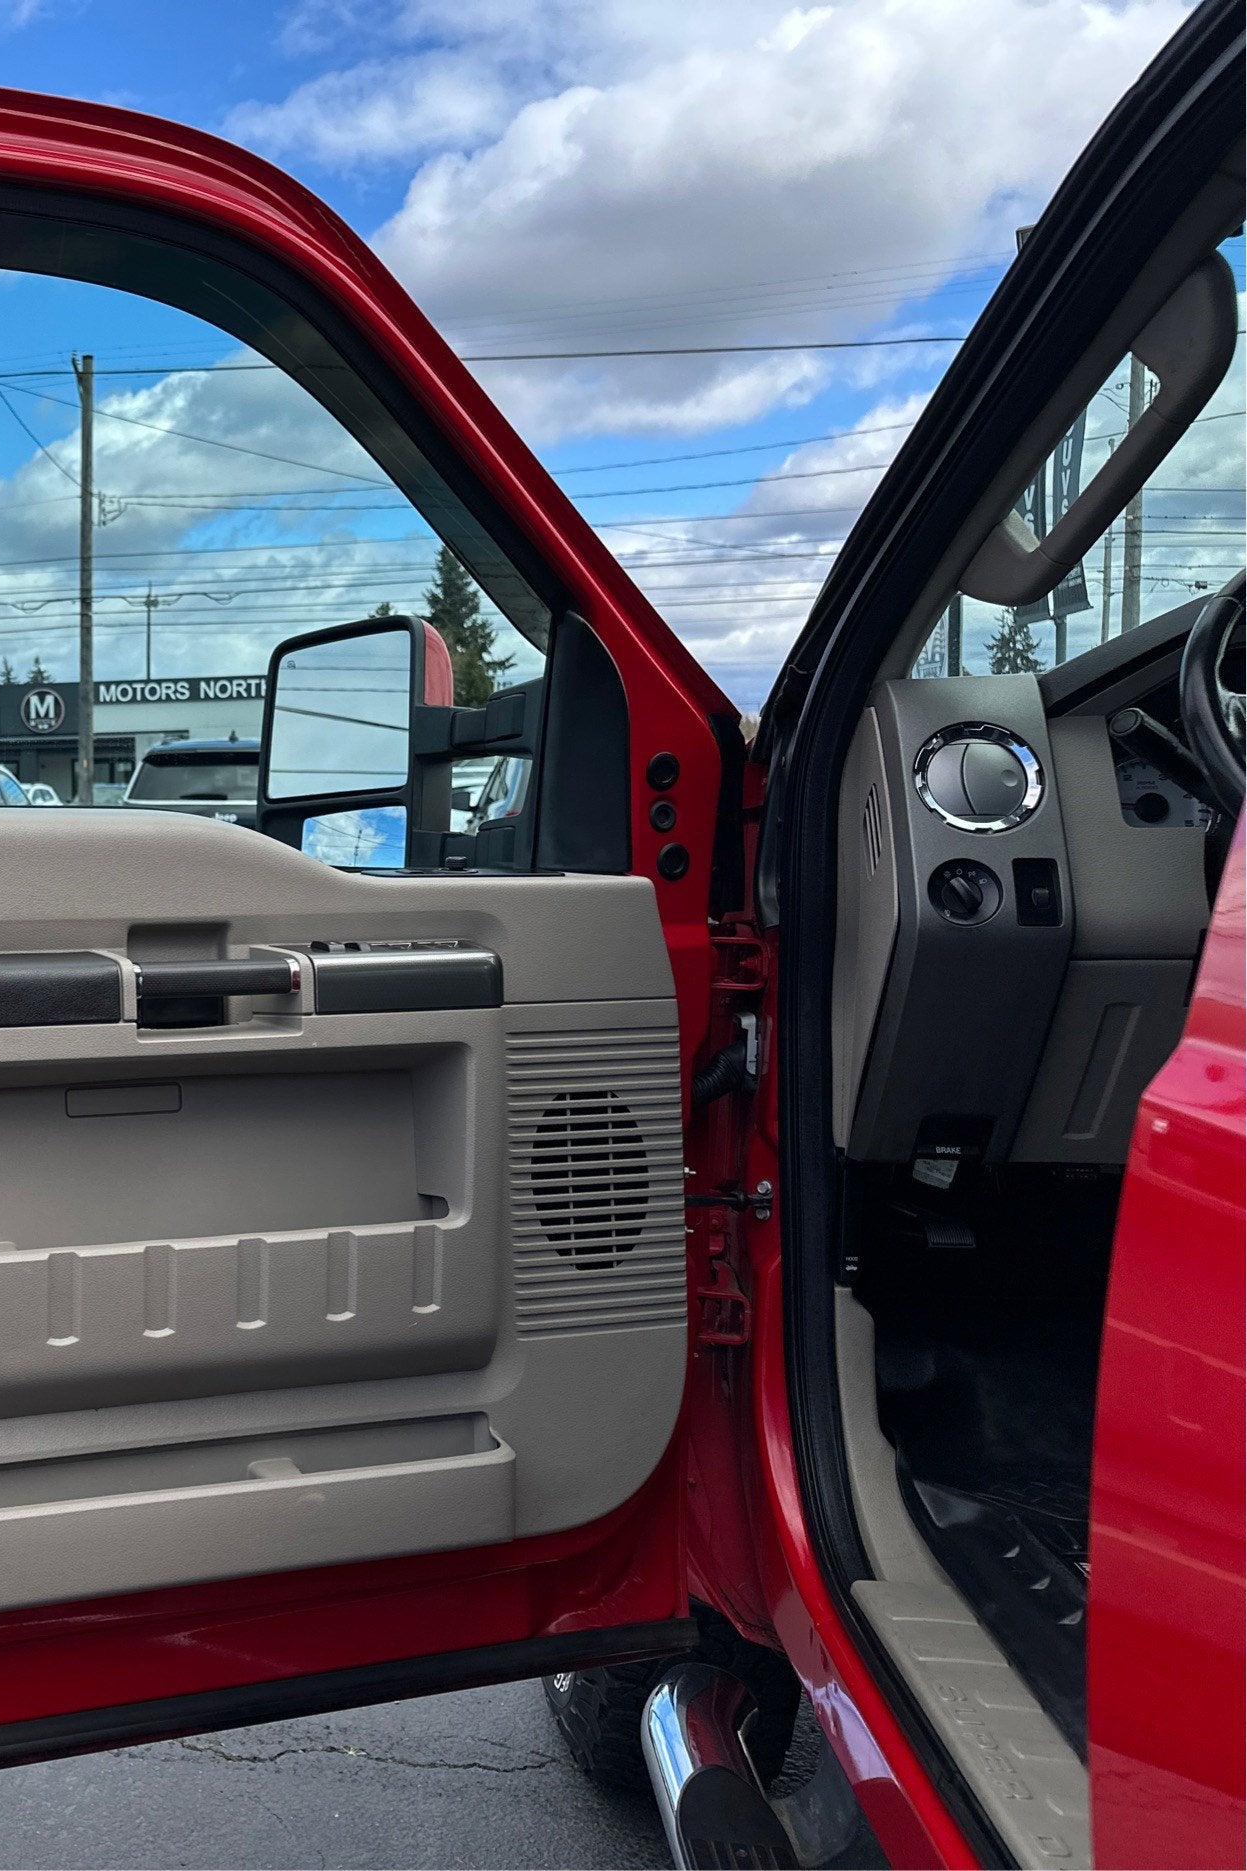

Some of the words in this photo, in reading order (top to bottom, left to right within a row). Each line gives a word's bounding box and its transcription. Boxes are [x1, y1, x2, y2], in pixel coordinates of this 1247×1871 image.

[1061, 424, 1074, 515] UVS
[99, 681, 190, 702] MOTORS
[29, 694, 55, 719] M
[935, 1146, 962, 1154] BRAKE
[934, 1683, 1034, 1800] SUPER
